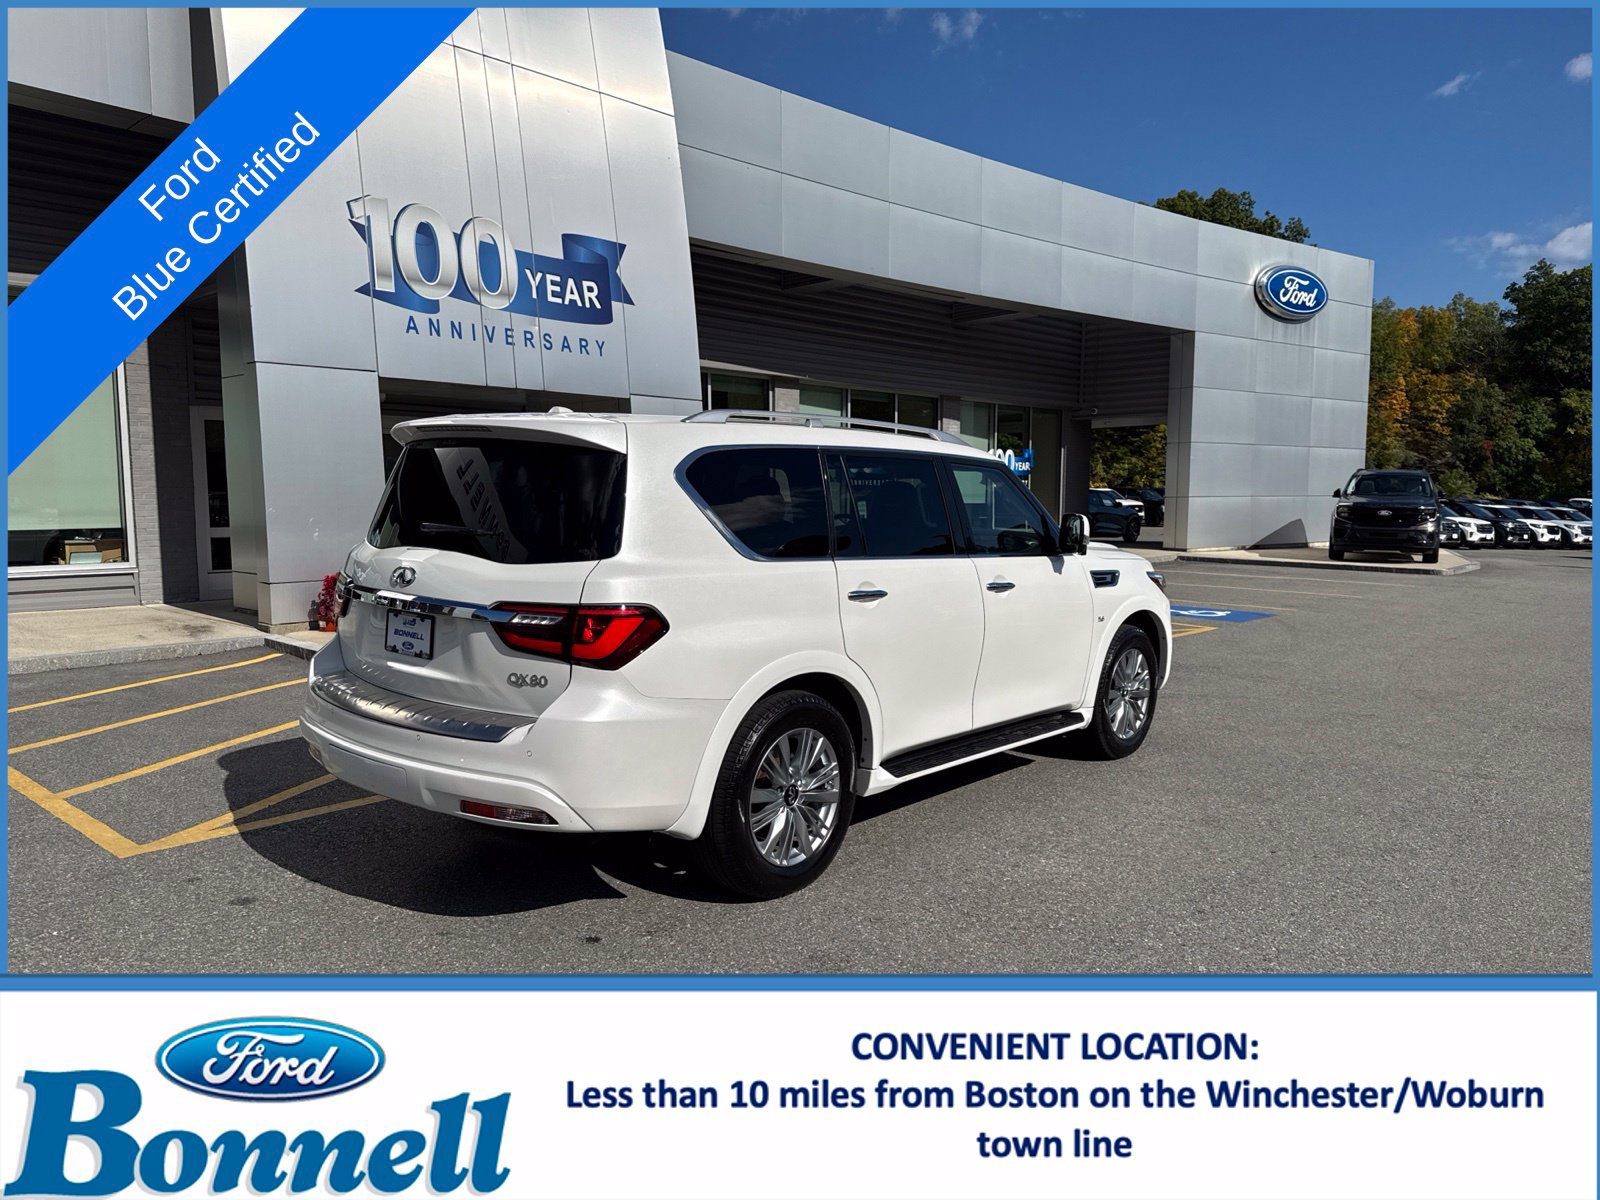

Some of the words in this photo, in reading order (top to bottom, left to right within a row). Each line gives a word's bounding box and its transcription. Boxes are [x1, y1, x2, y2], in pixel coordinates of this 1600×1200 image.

[346, 194, 518, 310] 100
[524, 268, 602, 309] YEAR
[1279, 275, 1318, 308] Ford
[405, 315, 606, 357] ANNIVERSARY
[1014, 461, 1031, 471] YEAR
[393, 628, 425, 641] BONNELL
[506, 672, 549, 689] QX80
